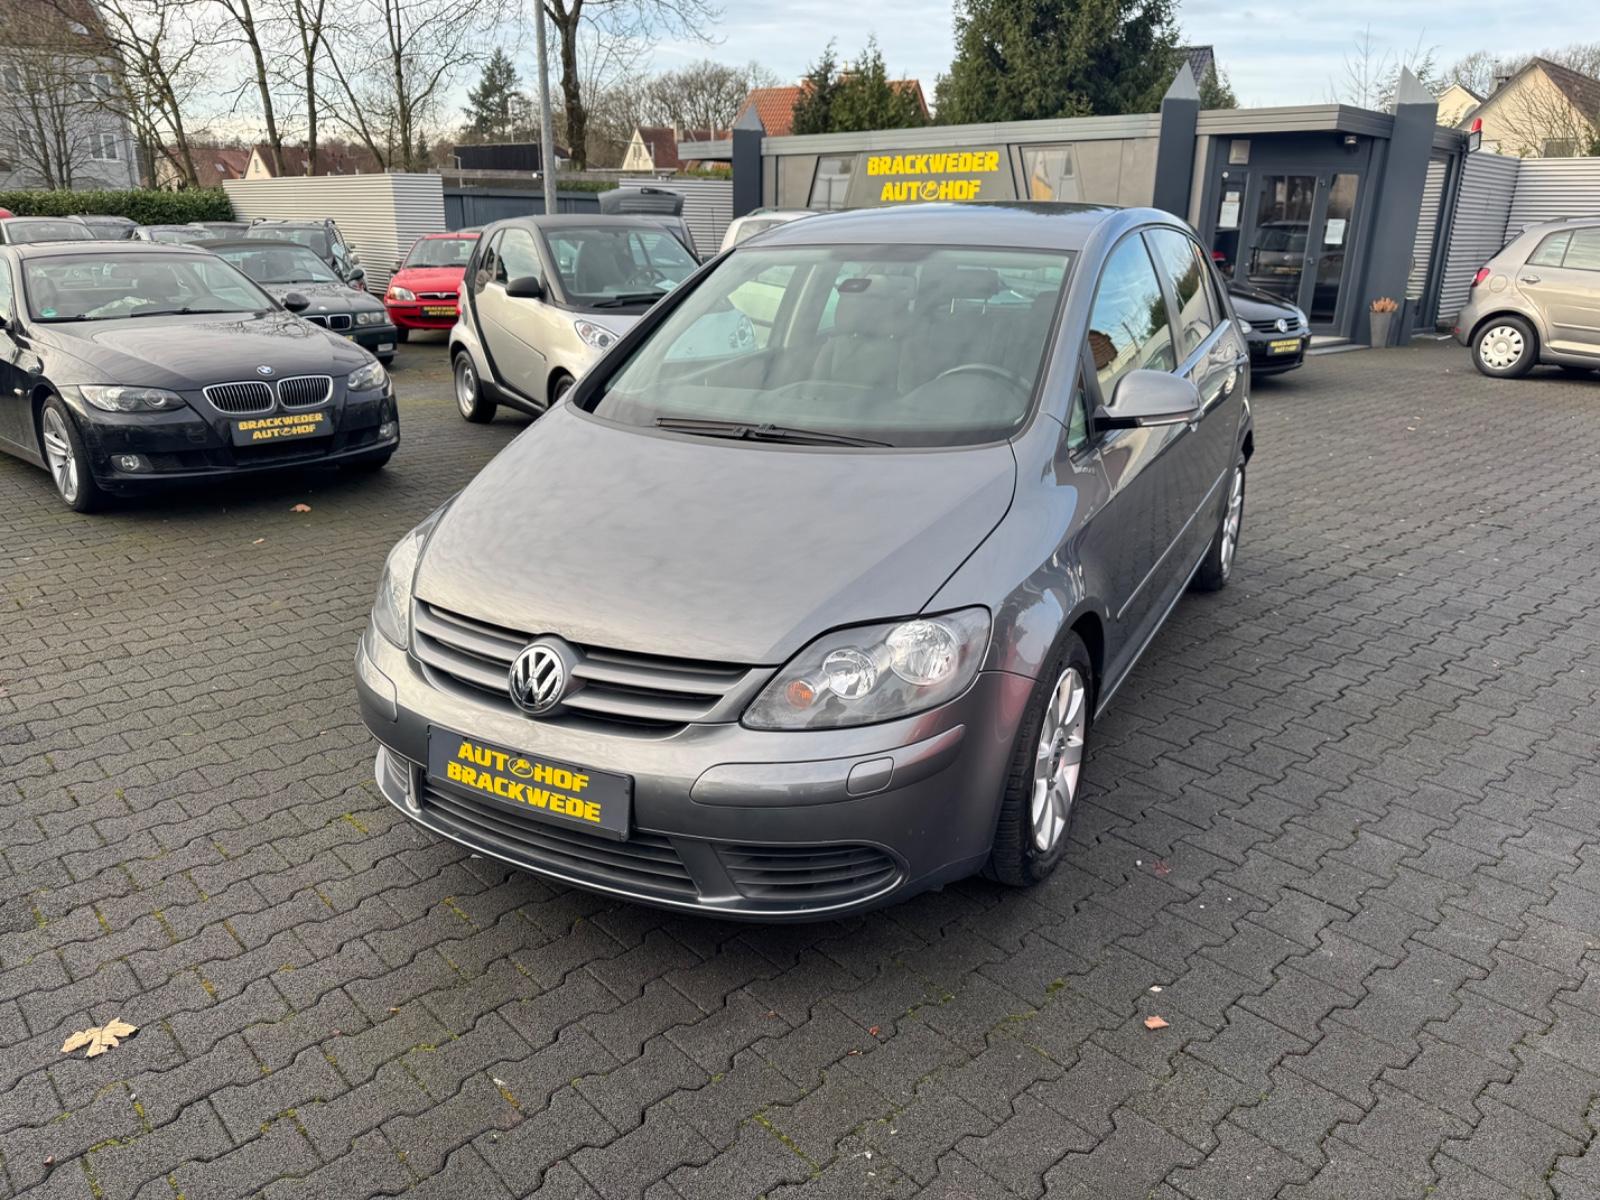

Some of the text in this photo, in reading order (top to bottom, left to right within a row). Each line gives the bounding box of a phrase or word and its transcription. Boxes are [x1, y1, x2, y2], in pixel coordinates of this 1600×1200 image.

[867, 151, 999, 176] BRACKWEDER
[880, 179, 982, 201] AUTOHOF
[239, 412, 324, 430] BRACKWEDER
[457, 741, 590, 793] AUTOHOF
[447, 760, 601, 823] BRACKWEDE
